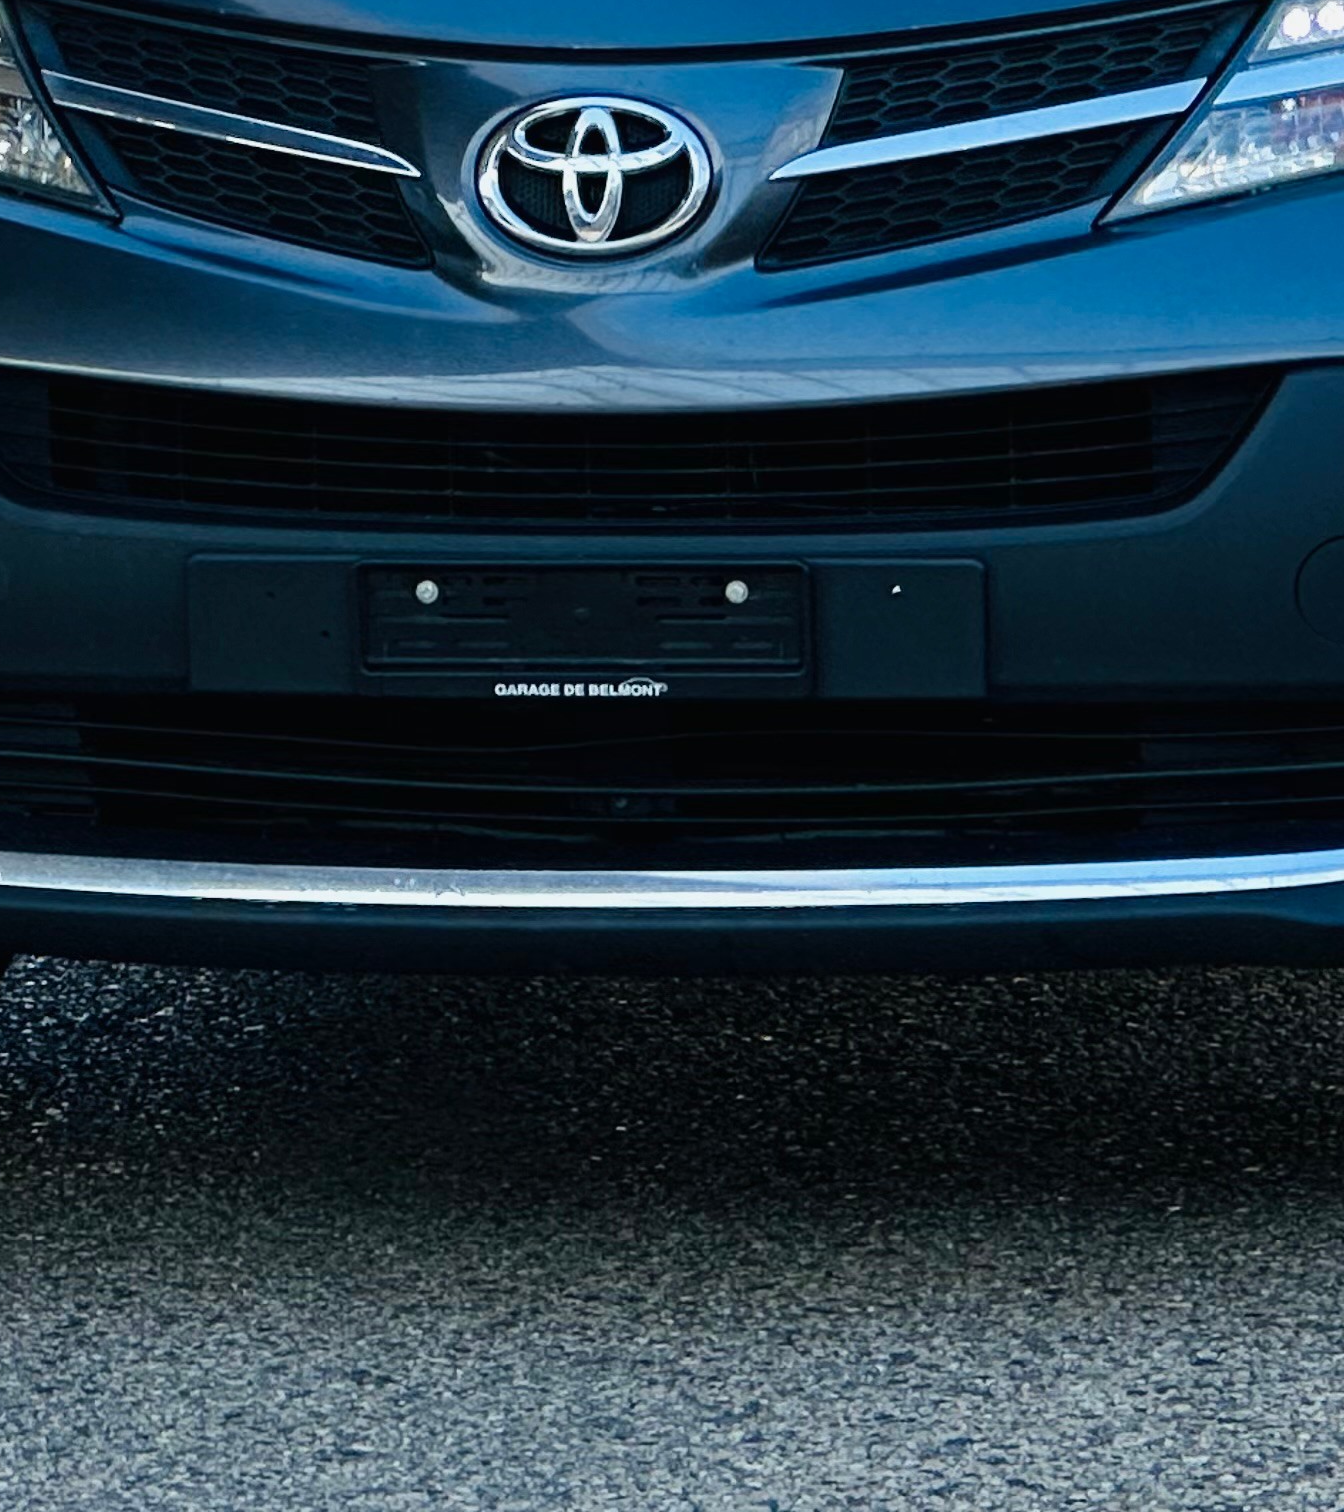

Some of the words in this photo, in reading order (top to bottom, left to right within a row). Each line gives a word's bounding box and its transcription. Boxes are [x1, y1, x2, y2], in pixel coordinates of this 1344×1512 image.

[494, 683, 560, 696] GARAGE
[563, 683, 585, 696] DE
[588, 682, 662, 696] BELMONT
